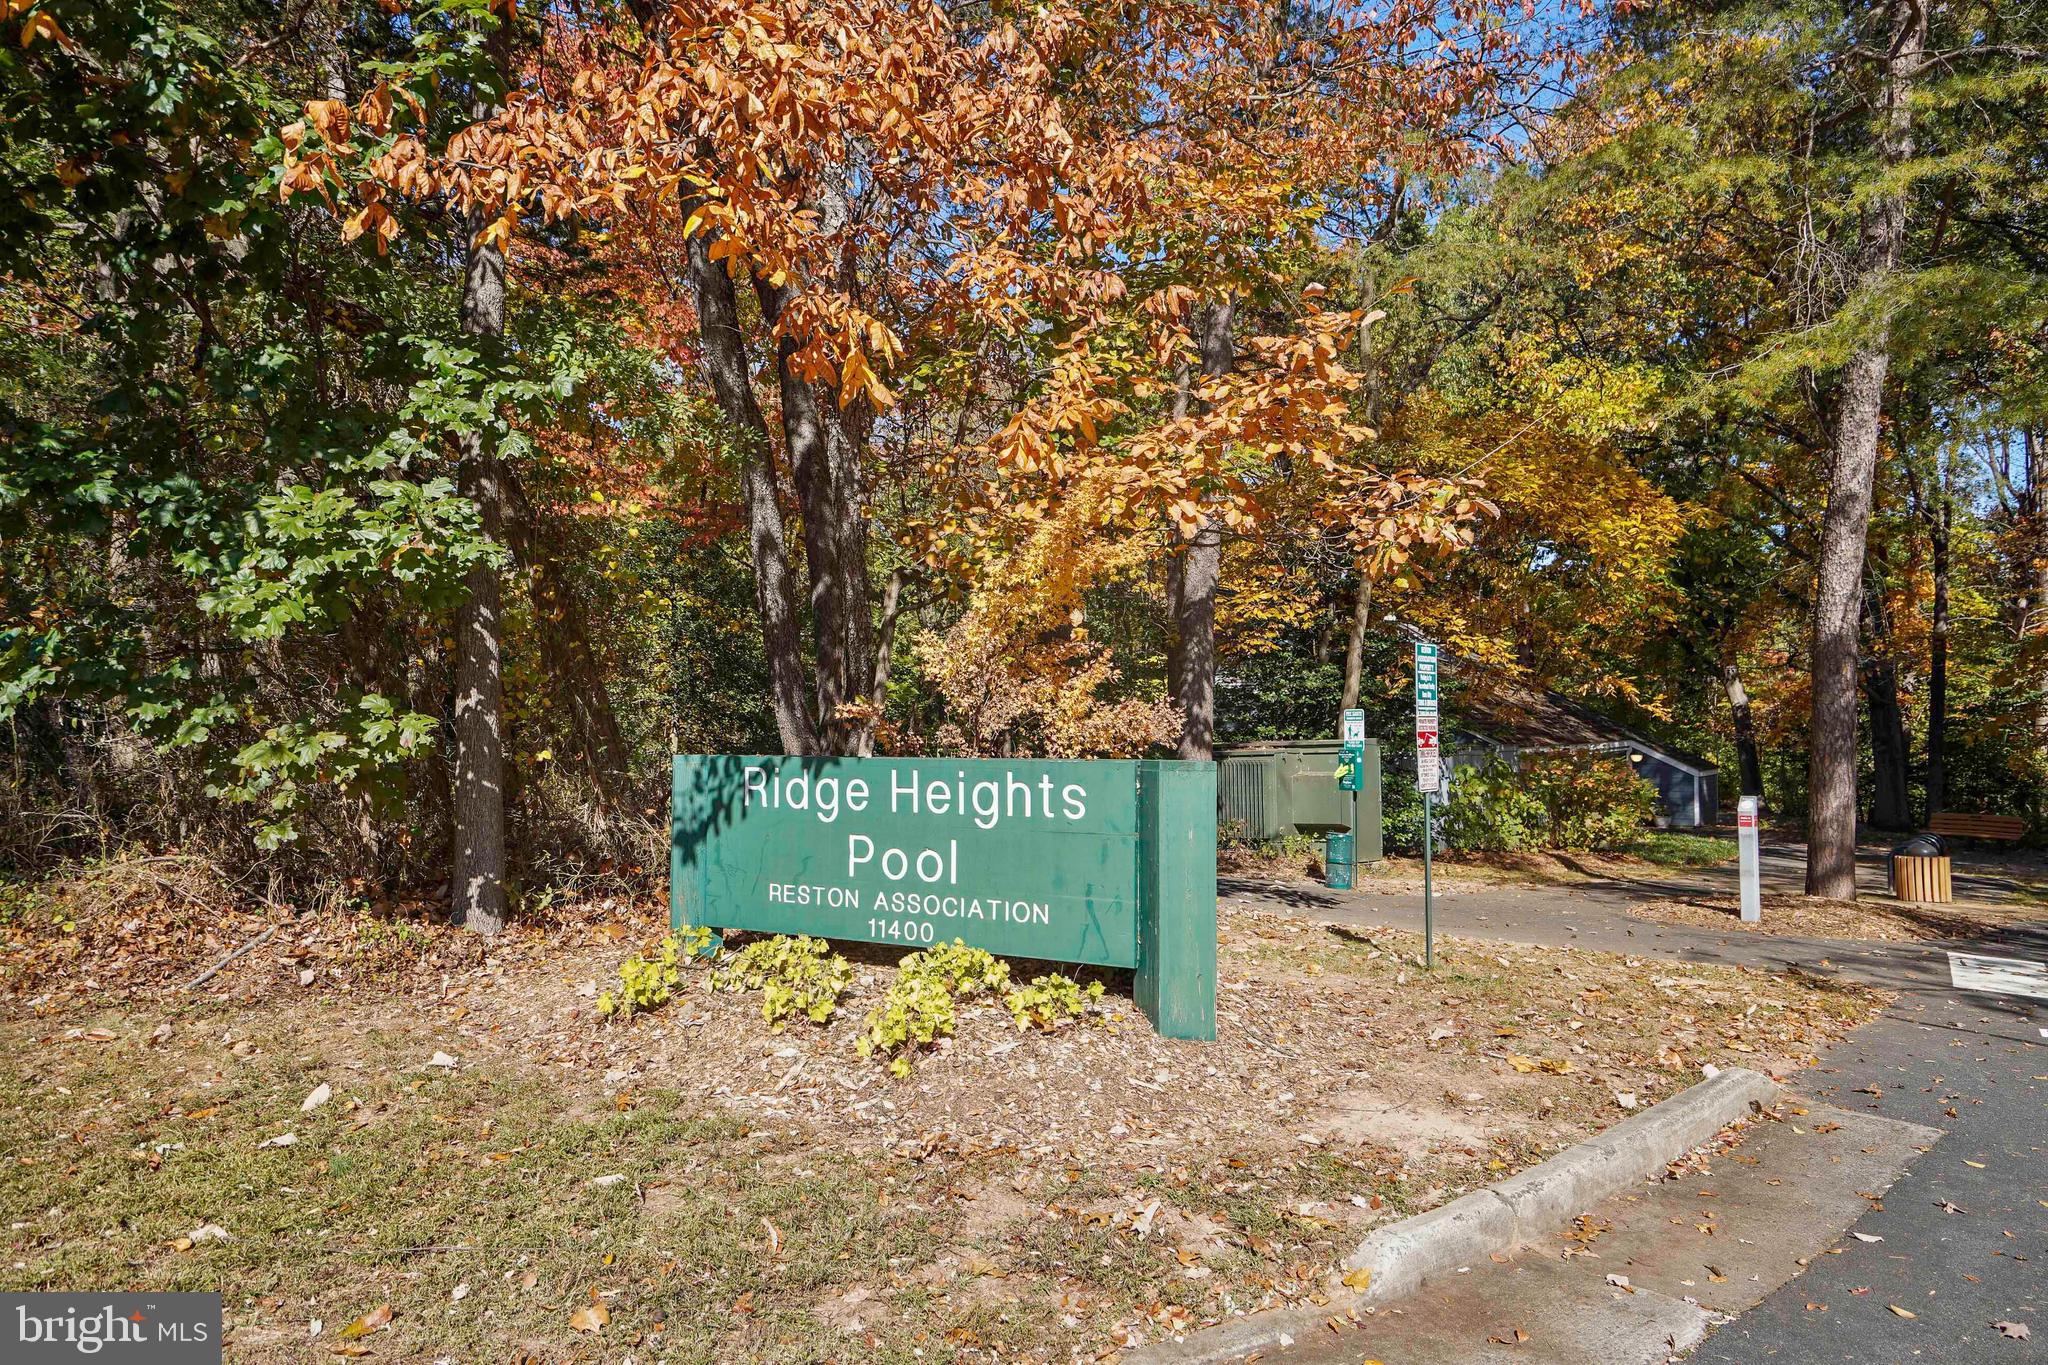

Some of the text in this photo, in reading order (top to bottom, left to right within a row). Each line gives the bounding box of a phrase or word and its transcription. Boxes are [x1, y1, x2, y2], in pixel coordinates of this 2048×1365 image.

[743, 765, 1087, 830] Ridge Heights
[848, 832, 959, 886] Pool
[768, 882, 1051, 926] RESTON ASSOCIATION
[867, 917, 936, 943] 11400
